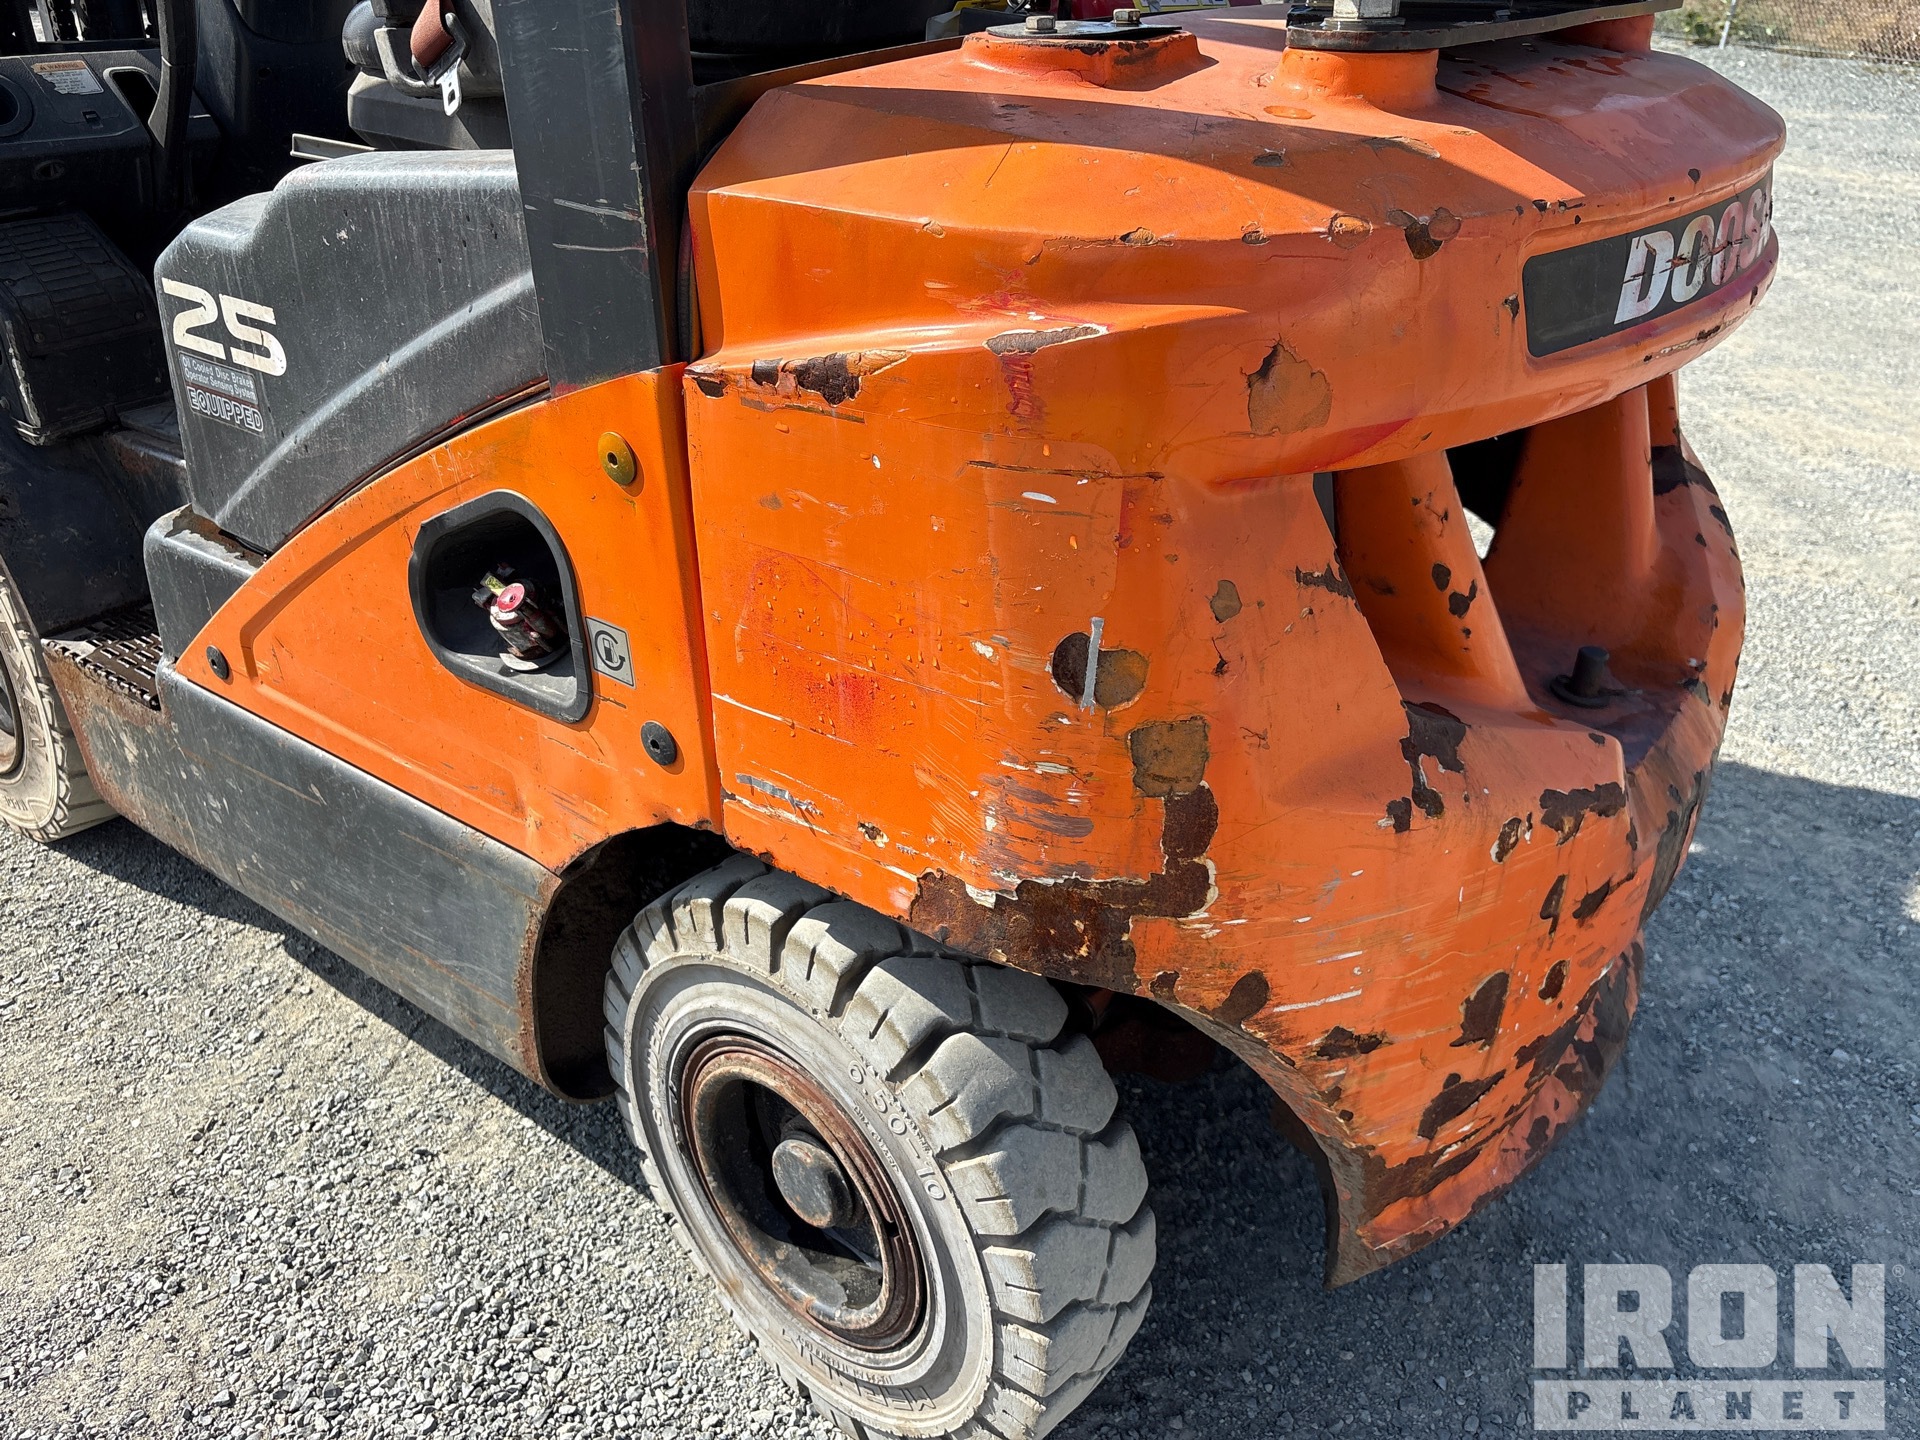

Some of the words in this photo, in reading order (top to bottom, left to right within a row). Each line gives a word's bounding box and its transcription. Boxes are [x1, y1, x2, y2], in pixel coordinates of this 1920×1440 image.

[161, 277, 287, 377] 25
[184, 367, 210, 386] Operator
[209, 375, 234, 396] Sensing
[233, 383, 258, 400] System
[192, 359, 214, 376] Cooled
[215, 367, 231, 382] Disc
[230, 372, 254, 390] Brakes
[186, 385, 264, 433] EQUIPPED
